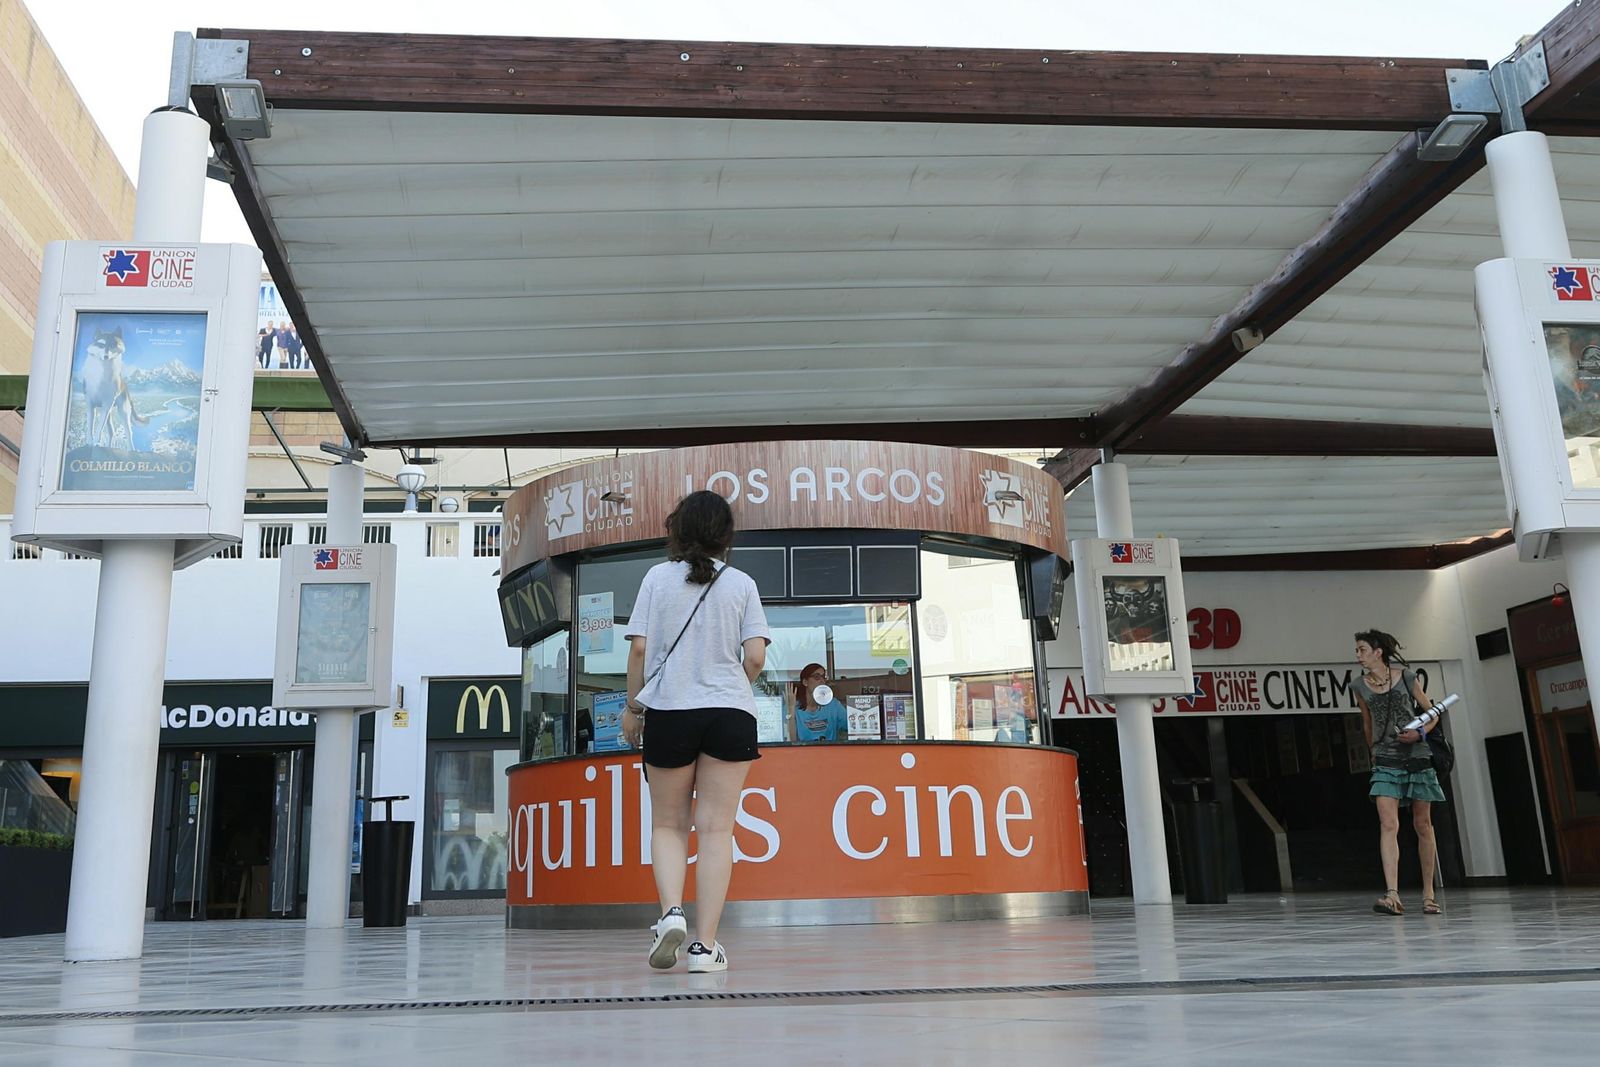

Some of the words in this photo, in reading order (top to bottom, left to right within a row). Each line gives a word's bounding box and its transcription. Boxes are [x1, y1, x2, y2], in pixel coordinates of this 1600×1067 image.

[152, 250, 196, 258] UNION
[151, 258, 194, 280] CINE
[150, 280, 193, 288] CIUDAD
[70, 459, 136, 473] COLMILLO
[137, 461, 193, 474] BLANCO
[585, 470, 633, 488] UNION
[789, 466, 946, 507] ARCOS
[586, 481, 634, 521] CINE
[1023, 488, 1051, 528] CINE
[504, 513, 521, 552] OS
[585, 516, 633, 533] CIUDAD
[339, 552, 362, 566] CINE
[1132, 547, 1154, 560] CINE
[1187, 607, 1242, 650] 3D
[1214, 670, 1257, 679] UNION
[1216, 679, 1260, 703] CINE
[1262, 669, 1364, 710] CINEM
[1550, 678, 1588, 694] Cruzcampo
[160, 704, 318, 729] cDonald
[1218, 703, 1261, 712] CIUDAD
[508, 763, 781, 899] quills
[831, 752, 1035, 861] cine
